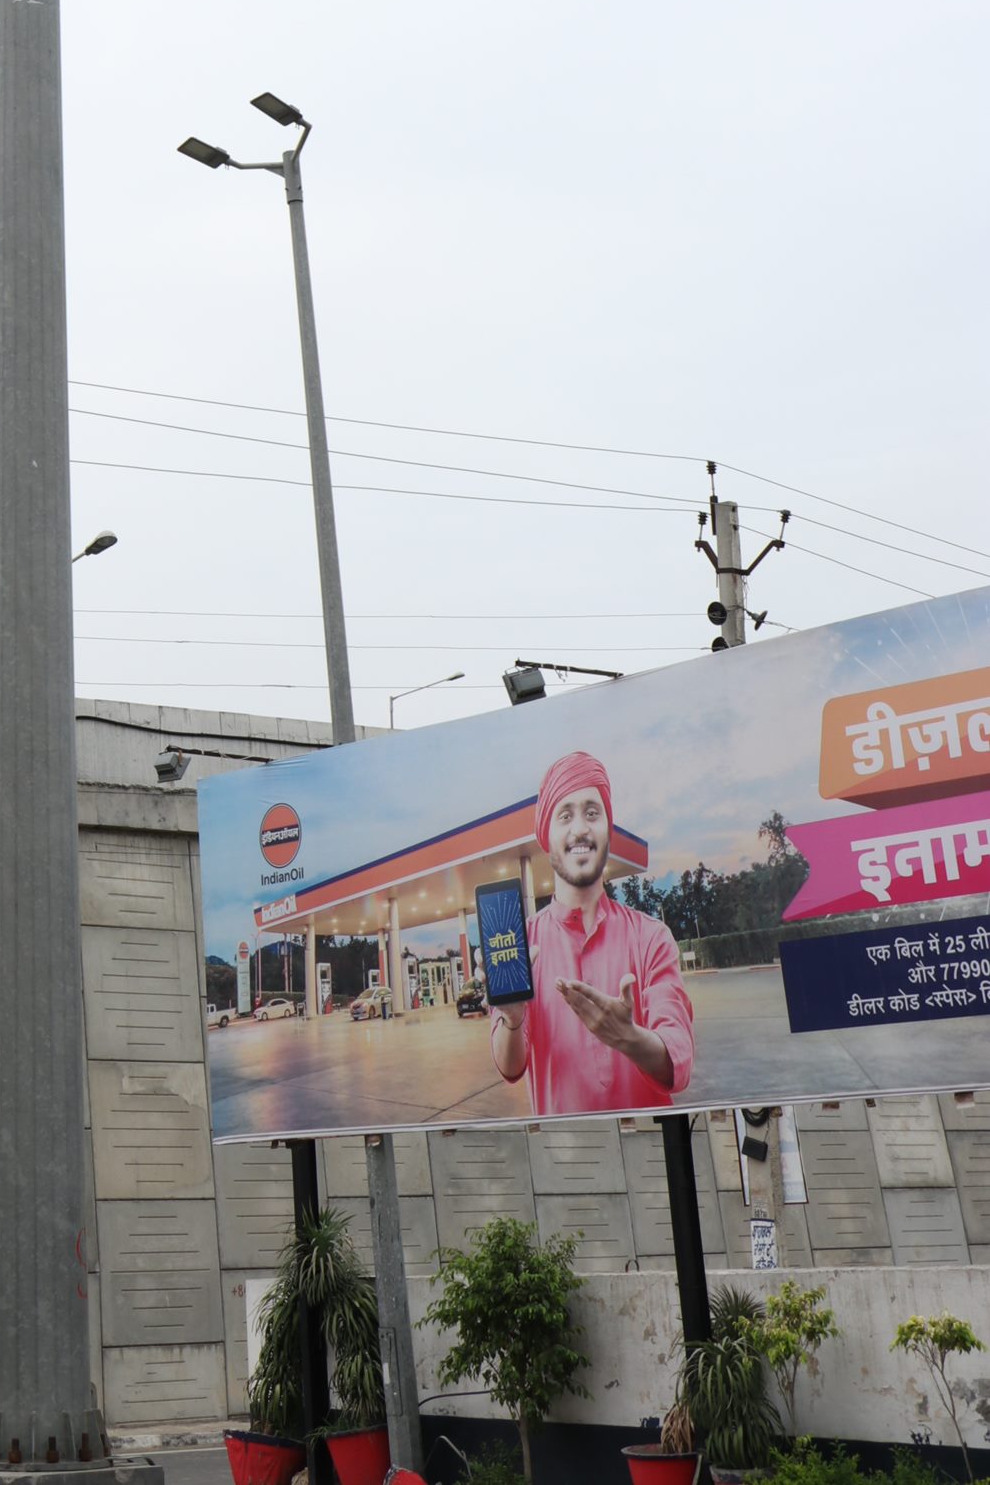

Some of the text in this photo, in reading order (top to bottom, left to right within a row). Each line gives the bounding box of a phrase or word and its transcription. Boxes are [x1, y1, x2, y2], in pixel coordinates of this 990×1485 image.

[261, 867, 304, 886] IndianOil
[489, 929, 516, 948] जीतो
[866, 944, 891, 965] एक
[894, 937, 924, 960] बिल
[927, 932, 941, 955] में
[945, 935, 966, 954] 25
[490, 947, 518, 967] इनाम
[907, 960, 936, 984] और
[847, 993, 885, 1016] डीलर
[888, 988, 920, 1012] कोड
